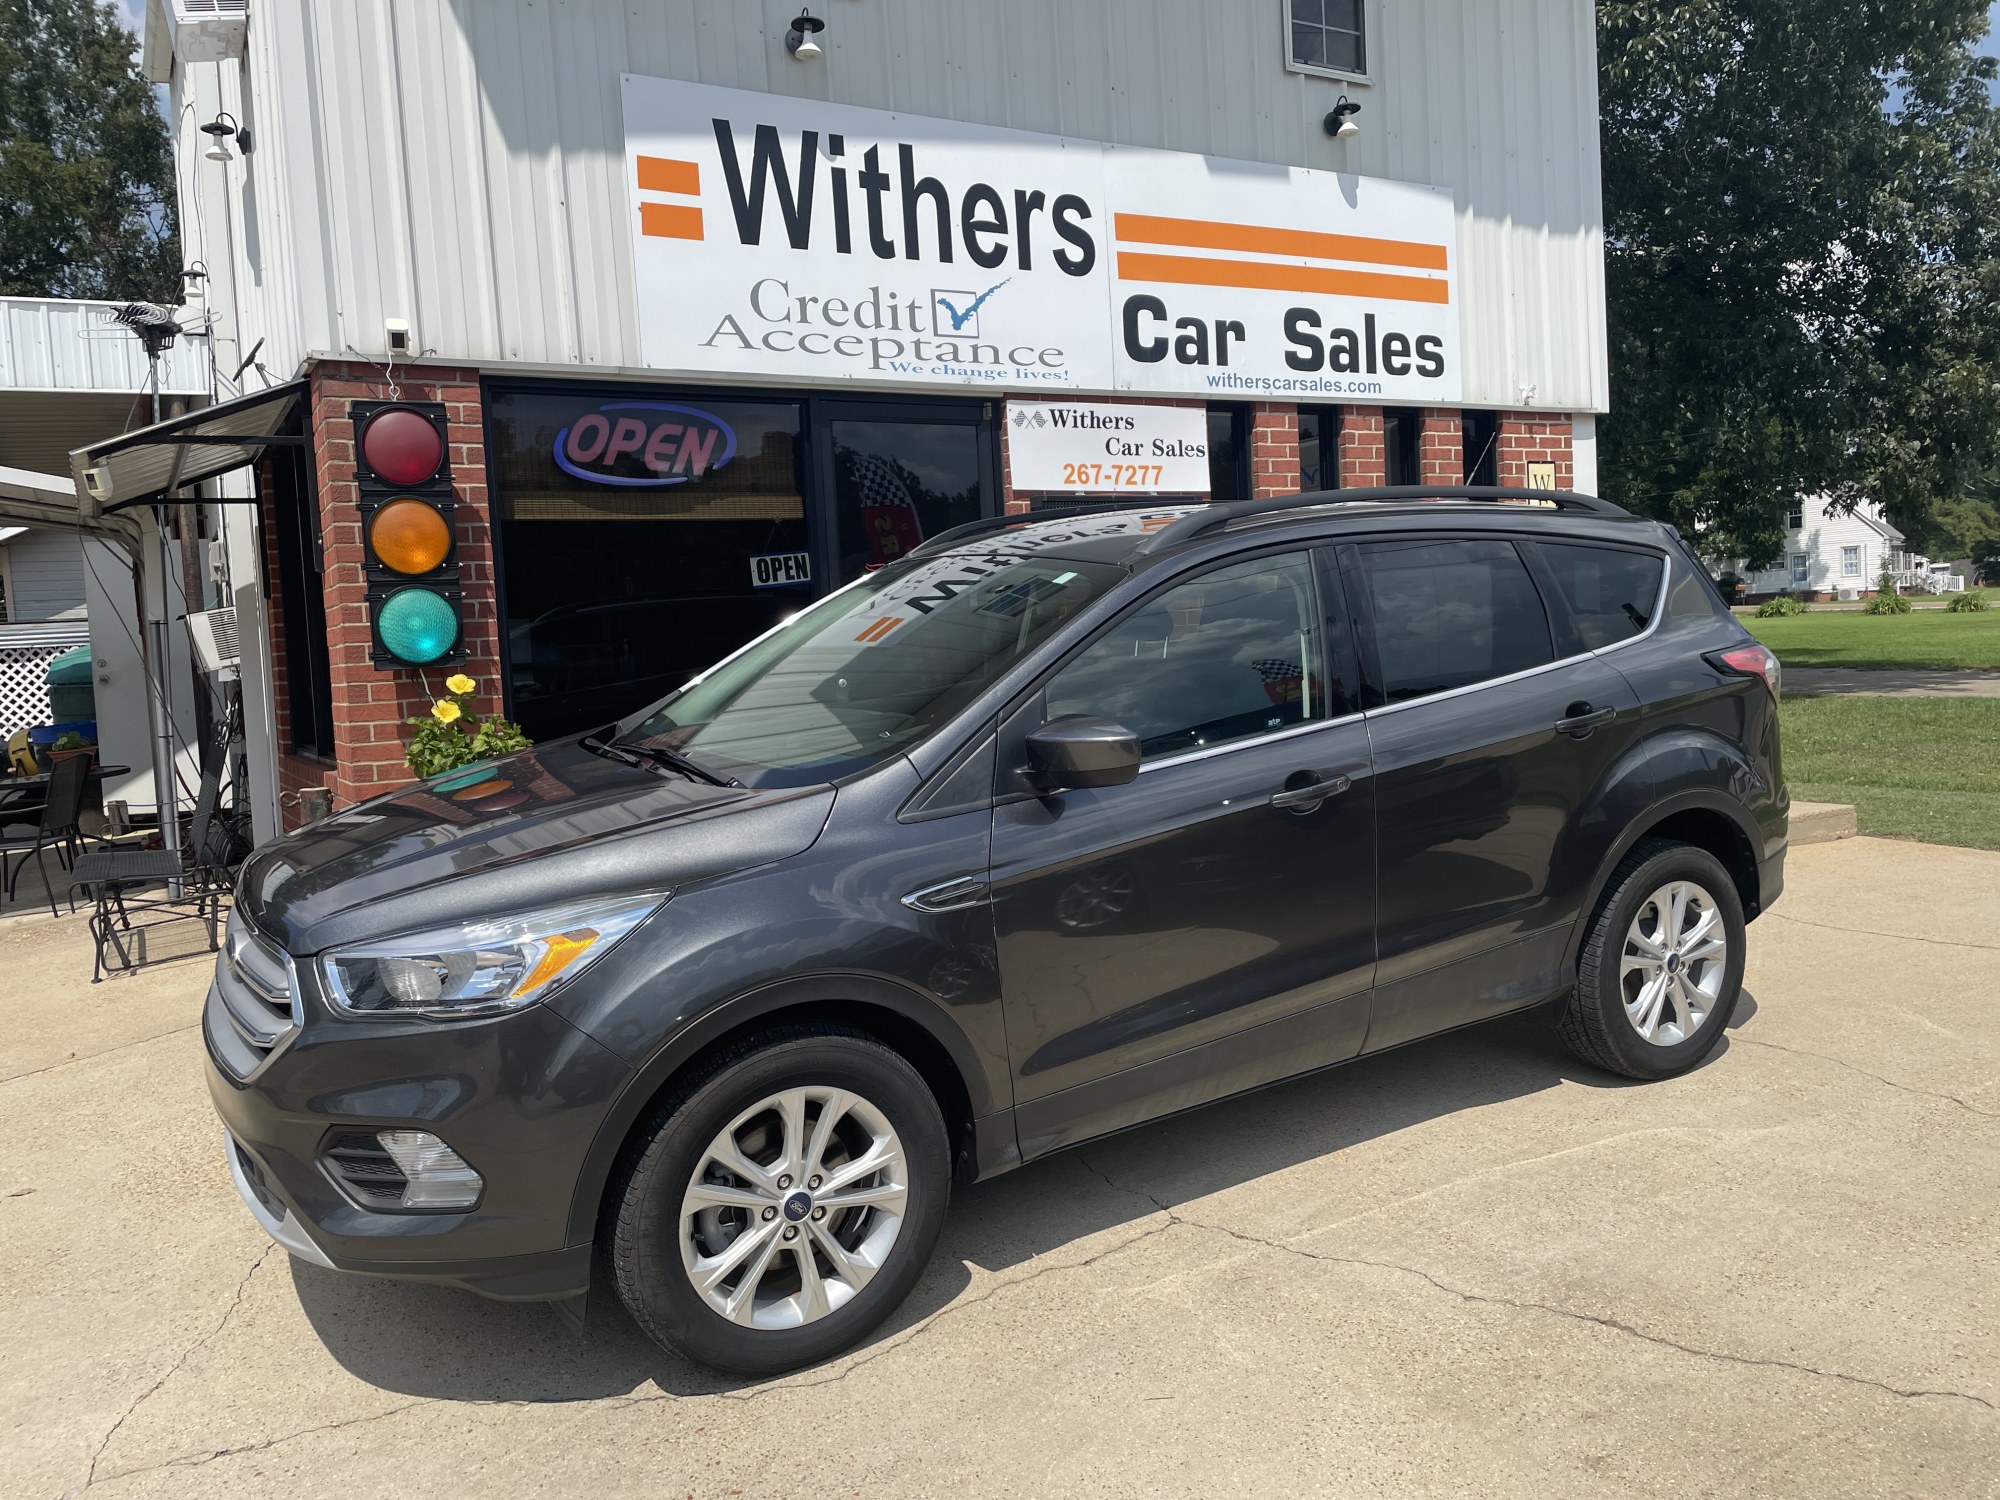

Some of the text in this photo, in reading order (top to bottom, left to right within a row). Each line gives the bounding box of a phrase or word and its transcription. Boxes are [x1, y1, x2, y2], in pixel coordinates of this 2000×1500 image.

[711, 117, 1096, 277] Withers
[749, 278, 925, 333] Credit
[698, 313, 1064, 371] Acceptance
[1122, 294, 1445, 378] Car Sales
[888, 361, 1069, 381] We change lives!
[1206, 373, 1382, 394] witherscarsales.com
[1049, 408, 1135, 430] Withers
[567, 413, 719, 476] OPEN
[1105, 436, 1206, 458] Car Sales
[1063, 463, 1163, 485] 267-7277
[756, 555, 809, 583] OPEN
